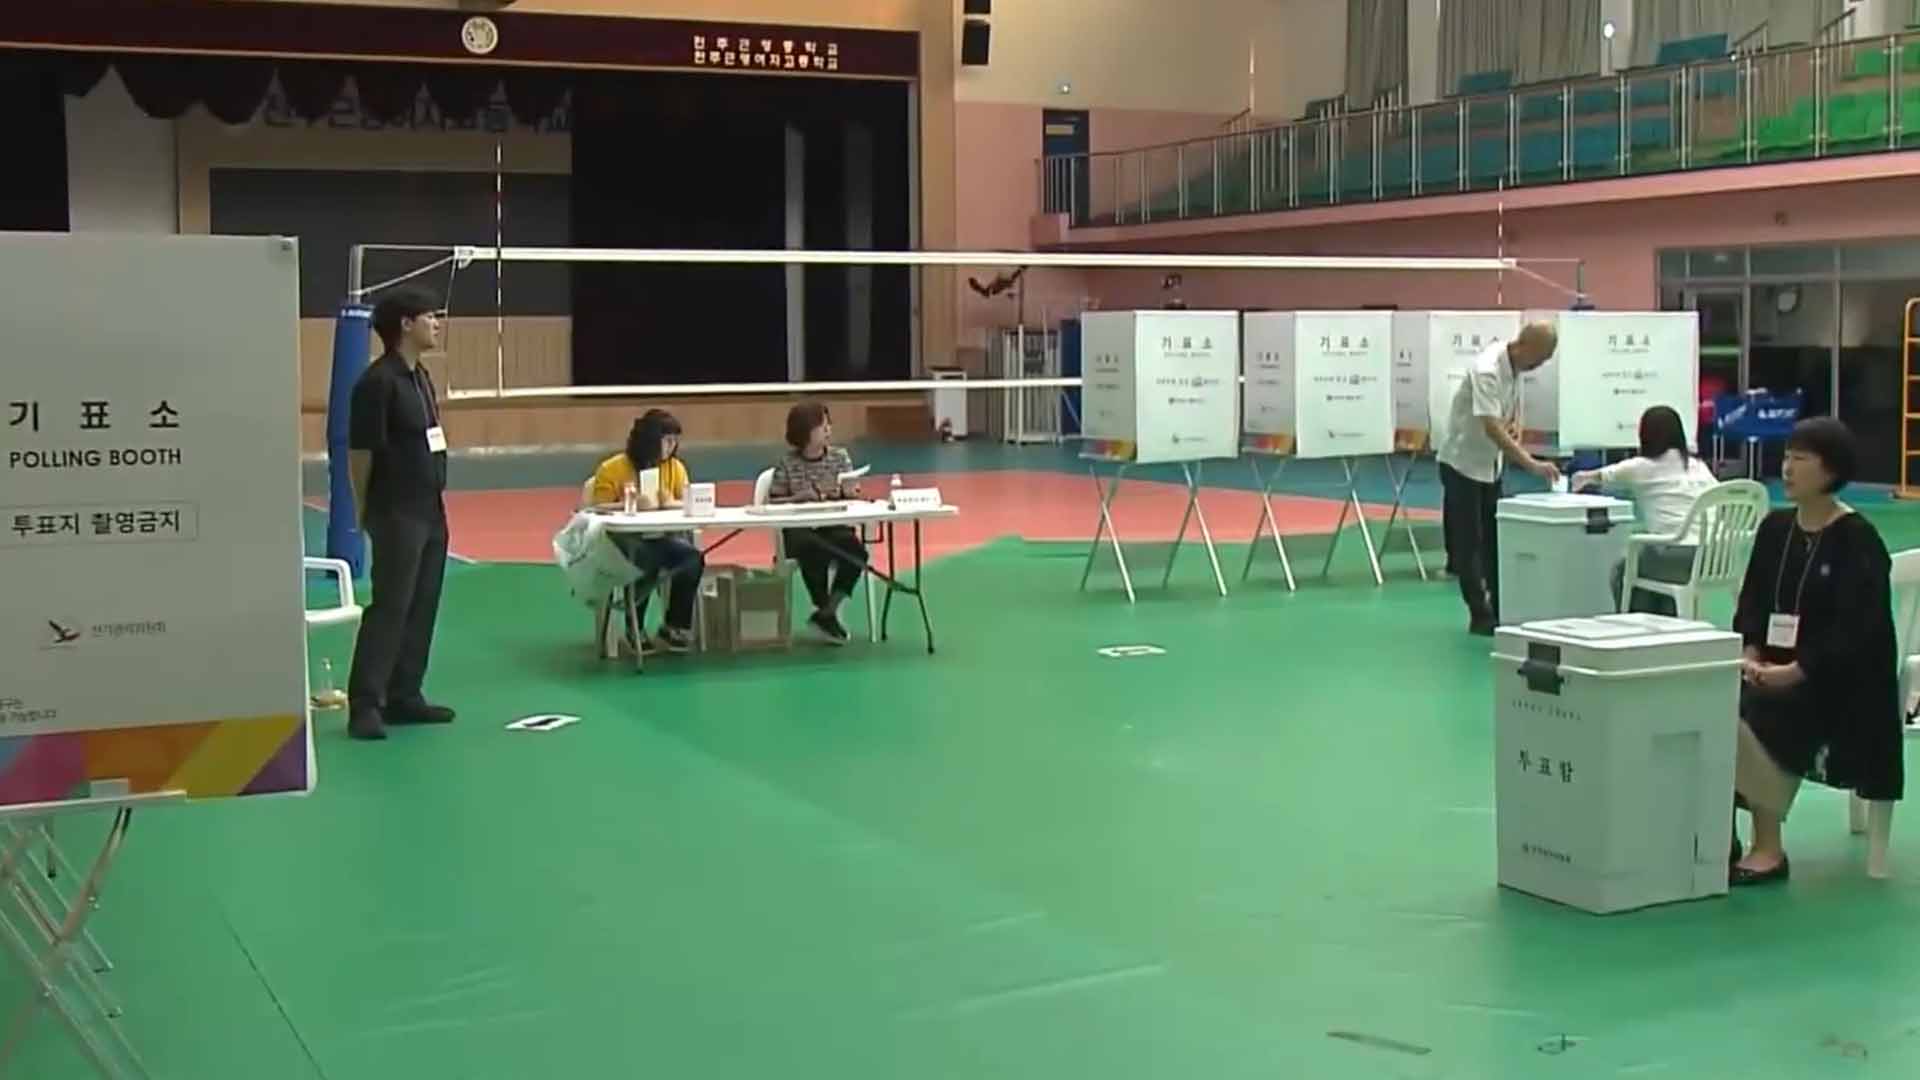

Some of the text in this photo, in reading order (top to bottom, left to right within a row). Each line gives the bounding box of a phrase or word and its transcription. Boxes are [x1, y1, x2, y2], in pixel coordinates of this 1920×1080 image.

[9, 448, 181, 469] POLLING BOOTH
[11, 510, 181, 537] 투표지 촬영금지
